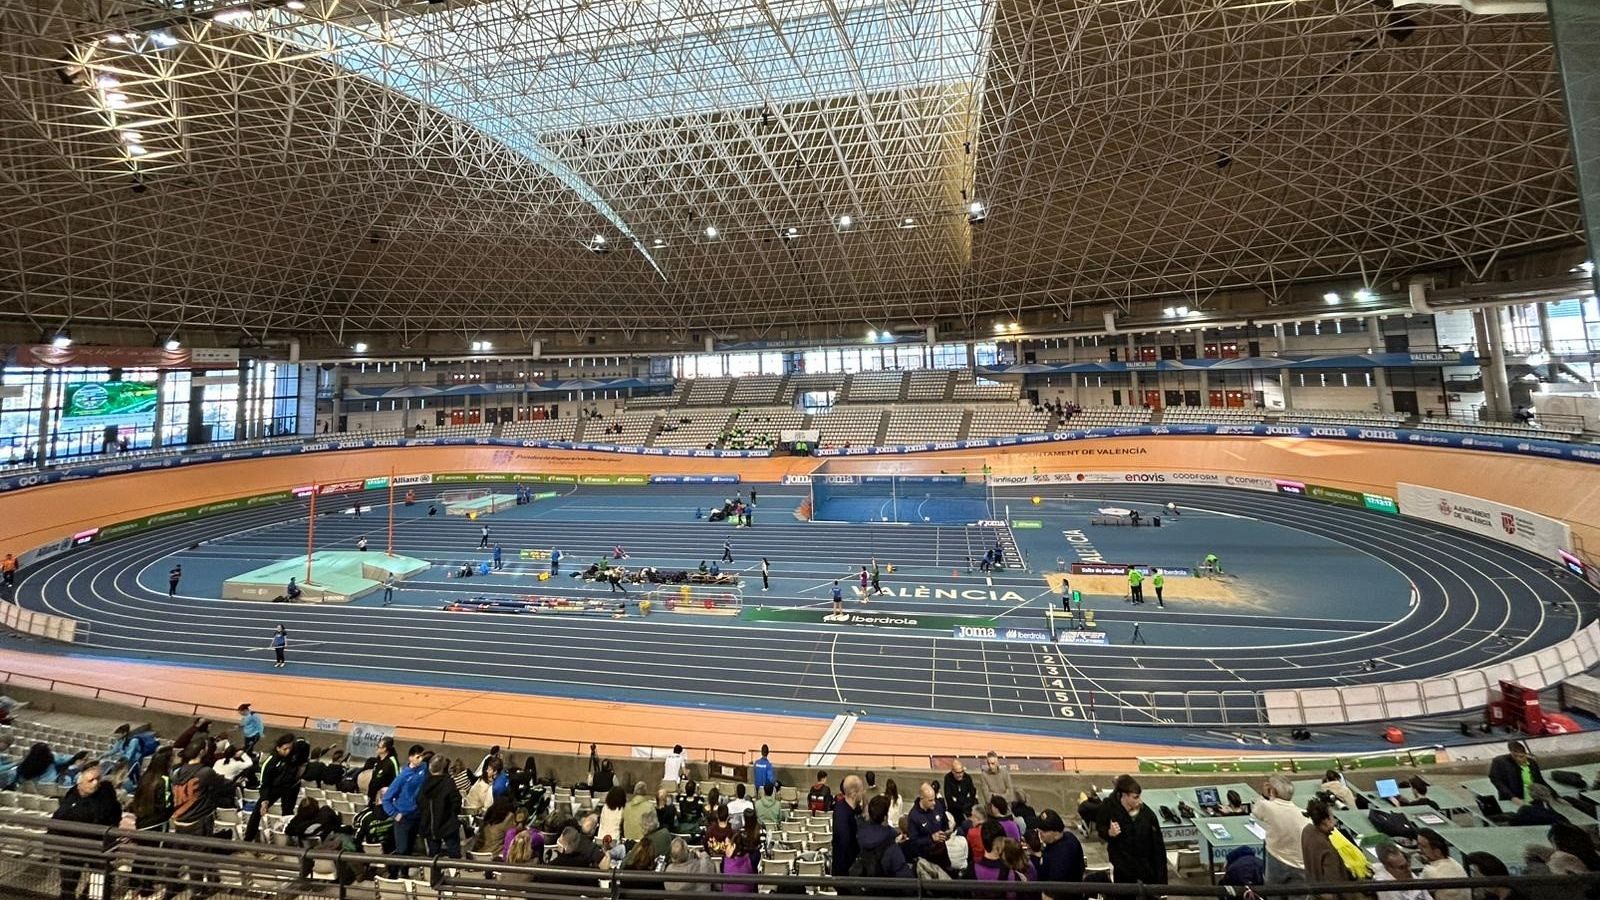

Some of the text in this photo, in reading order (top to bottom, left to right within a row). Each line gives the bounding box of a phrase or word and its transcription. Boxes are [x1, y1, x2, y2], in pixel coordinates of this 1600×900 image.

[393, 475, 419, 484] Allianz
[1125, 473, 1165, 482] enovis
[851, 585, 1026, 603] VALÈNCIA
[851, 615, 918, 626] Iberdrola
[959, 626, 997, 639] Joma
[1018, 631, 1046, 641] Iberdrola
[1041, 645, 1049, 653] 1
[1043, 655, 1055, 664] 2
[1046, 666, 1059, 675] 3
[1052, 679, 1064, 688] 4
[1055, 692, 1069, 702] 5
[1060, 706, 1074, 717] 6
